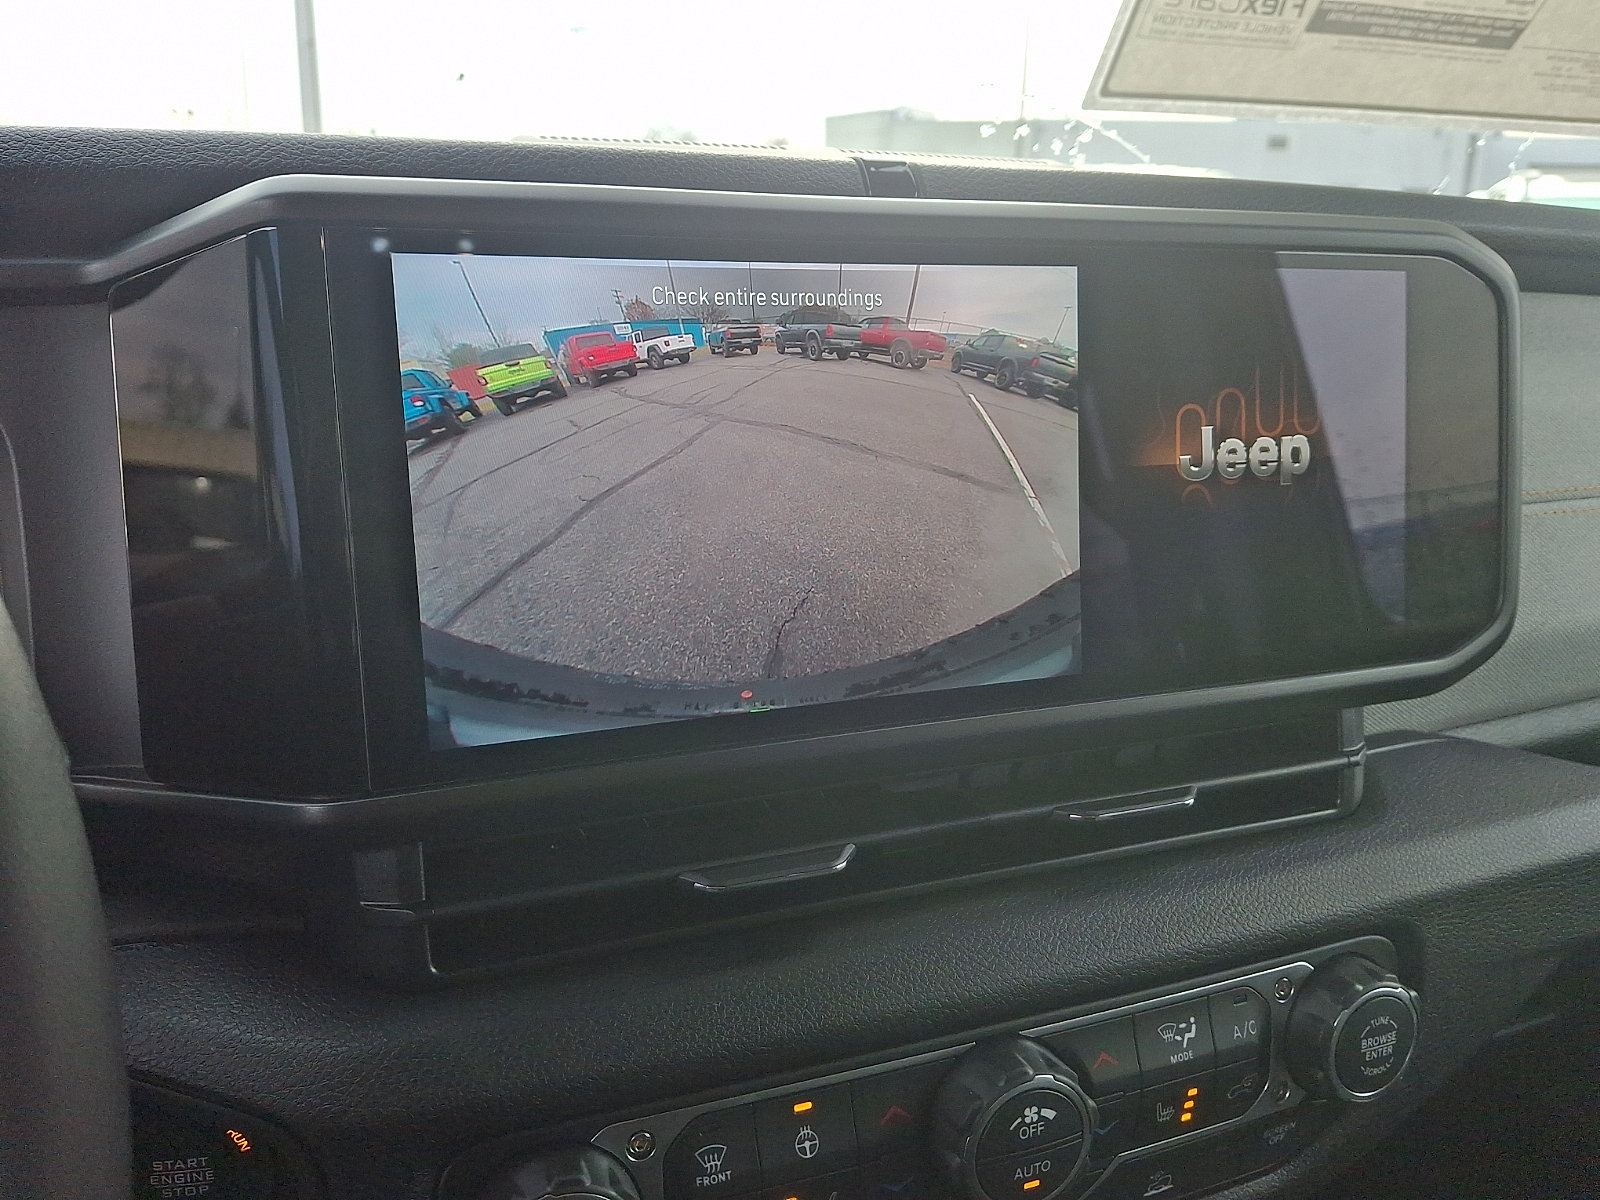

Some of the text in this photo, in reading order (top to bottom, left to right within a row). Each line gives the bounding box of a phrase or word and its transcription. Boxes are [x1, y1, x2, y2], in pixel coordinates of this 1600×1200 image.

[651, 285, 883, 311] Check entire surroundings
[1178, 425, 1311, 486] Jeep
[1233, 1019, 1257, 1041] A/C
[1370, 1015, 1390, 1028] TUNE
[1361, 1031, 1397, 1049] BROWSE
[1170, 1050, 1194, 1065] MODE
[1365, 1045, 1393, 1061] ENTER
[1363, 1061, 1391, 1076] SCROLL
[1018, 1122, 1046, 1140] OFF
[152, 1157, 209, 1171] START
[1014, 1159, 1051, 1181] AUTO
[150, 1170, 215, 1185] ENGINE
[695, 1170, 732, 1188] FRONT
[162, 1185, 210, 1199] STOP
